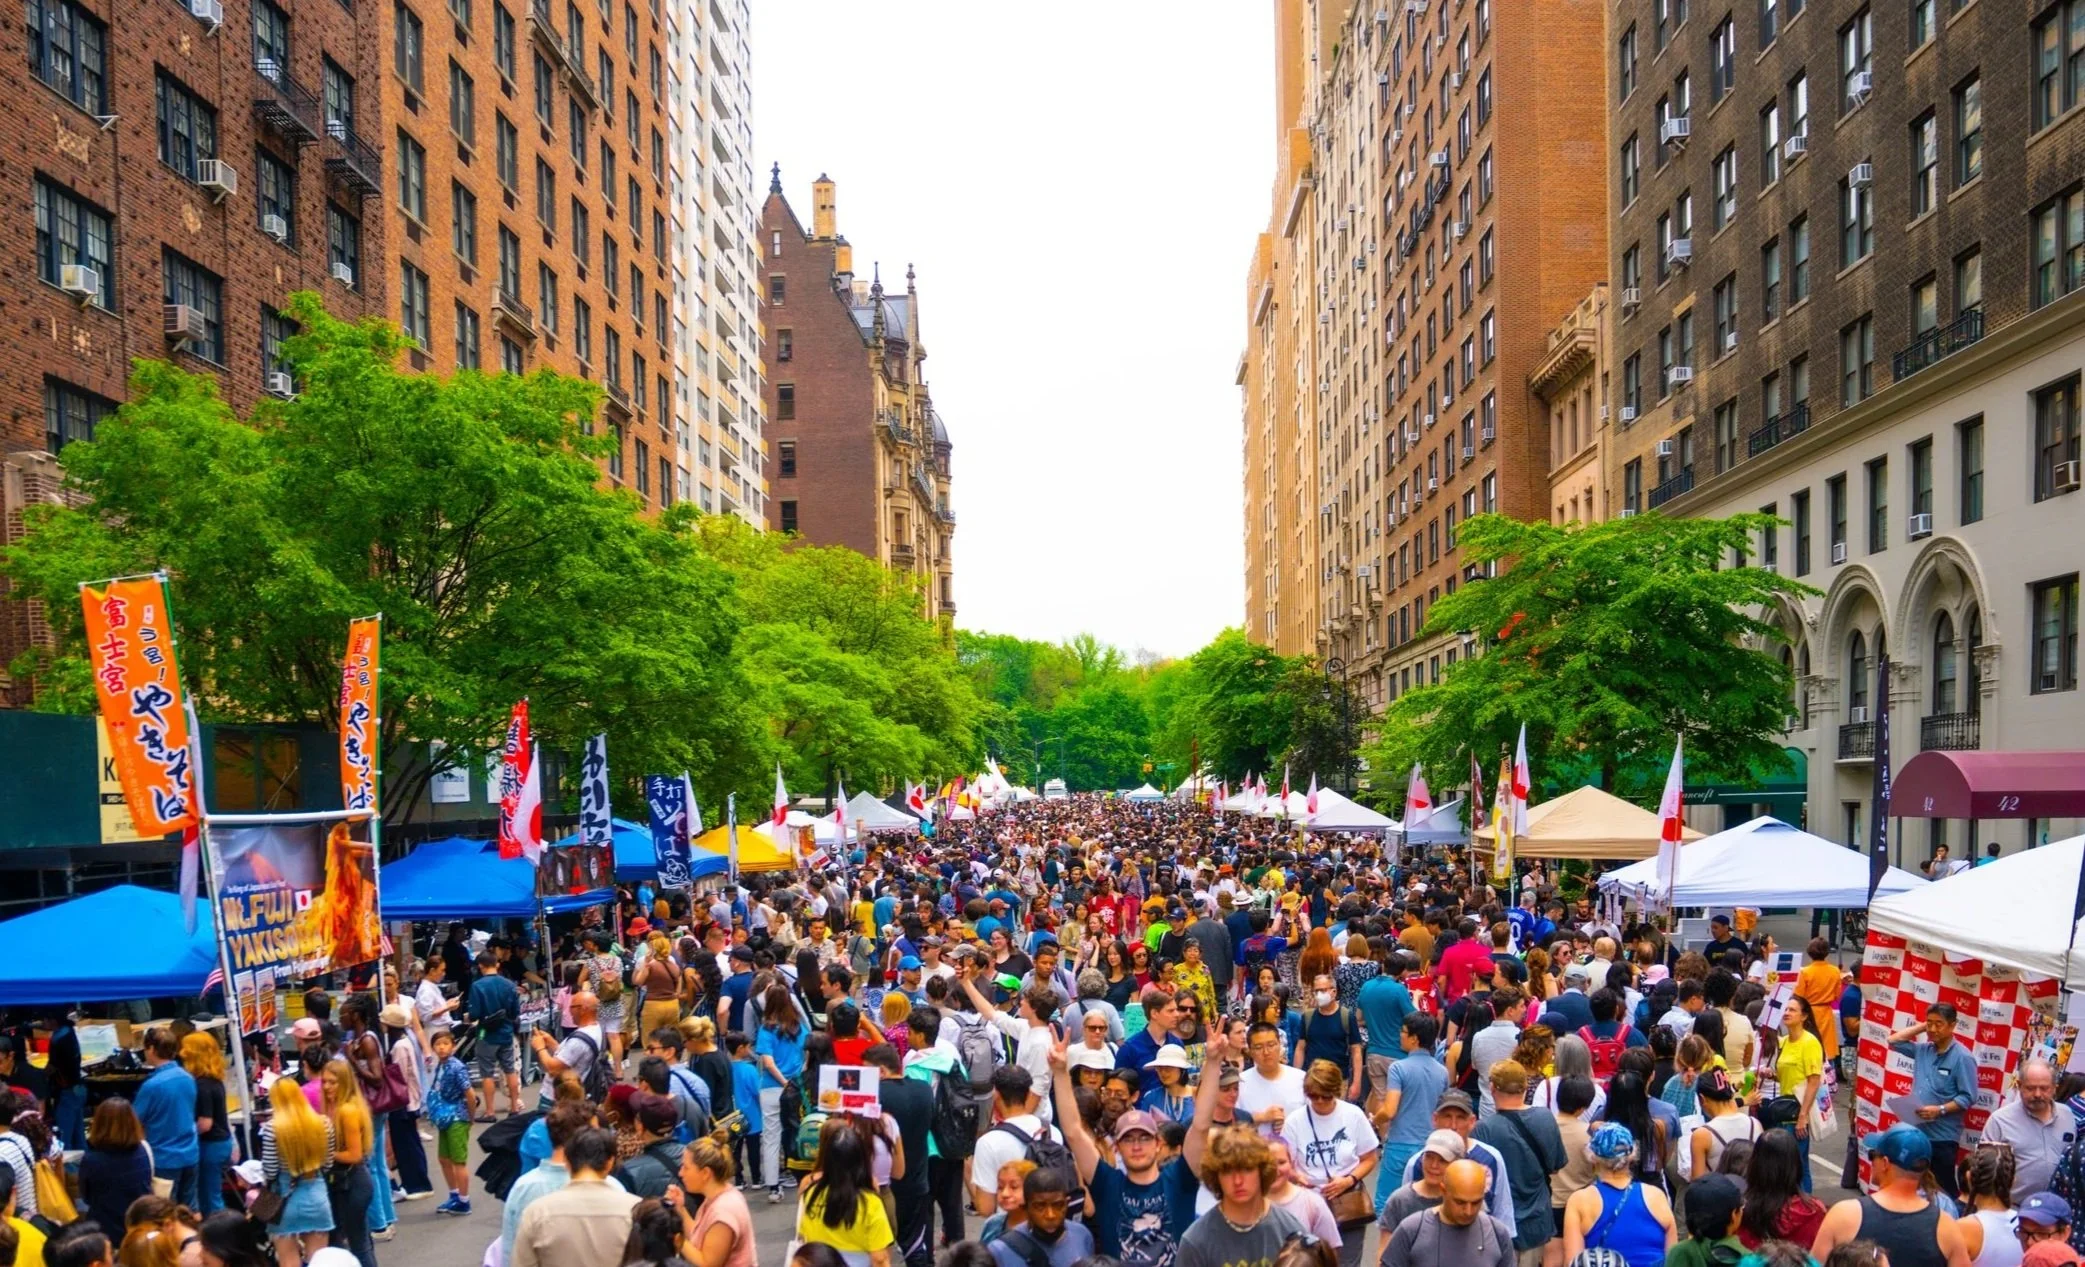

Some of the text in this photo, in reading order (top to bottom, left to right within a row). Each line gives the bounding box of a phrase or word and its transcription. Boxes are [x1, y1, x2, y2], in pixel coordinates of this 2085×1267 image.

[99, 596, 127, 695] 富士宮
[132, 684, 191, 822] やきそば
[1923, 796, 1934, 812] 42
[1997, 795, 2020, 812] 42
[227, 921, 323, 970] YAKISOBA
[1896, 1057, 1913, 1069] JAPA
